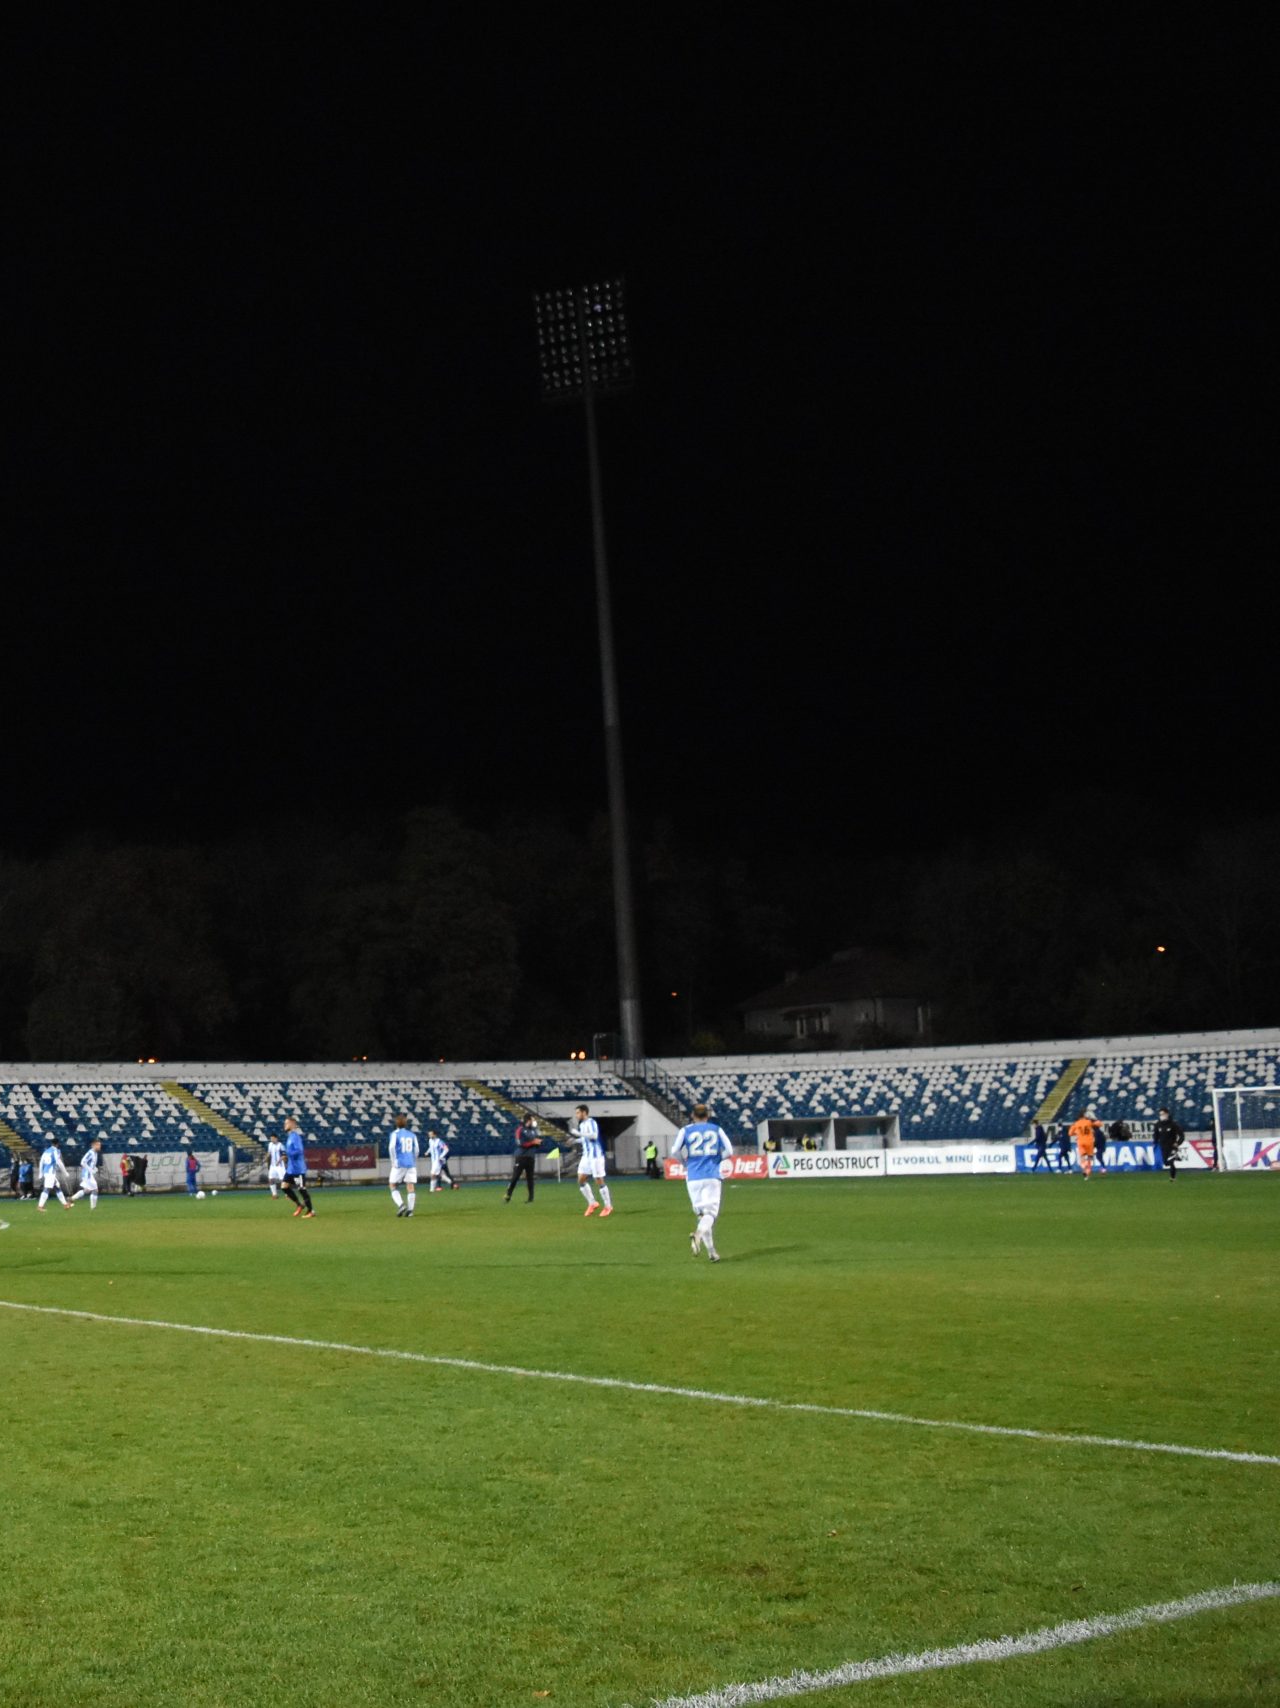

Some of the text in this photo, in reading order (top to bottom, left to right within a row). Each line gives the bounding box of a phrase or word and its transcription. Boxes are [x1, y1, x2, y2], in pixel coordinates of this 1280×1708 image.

[401, 1137, 413, 1153] 18
[688, 1131, 718, 1155] 22
[793, 1156, 880, 1170] PEG CONSTRUCT
[892, 1154, 1009, 1166] IZVORUL MINUILOR
[1023, 1145, 1155, 1168] DEDMAN
